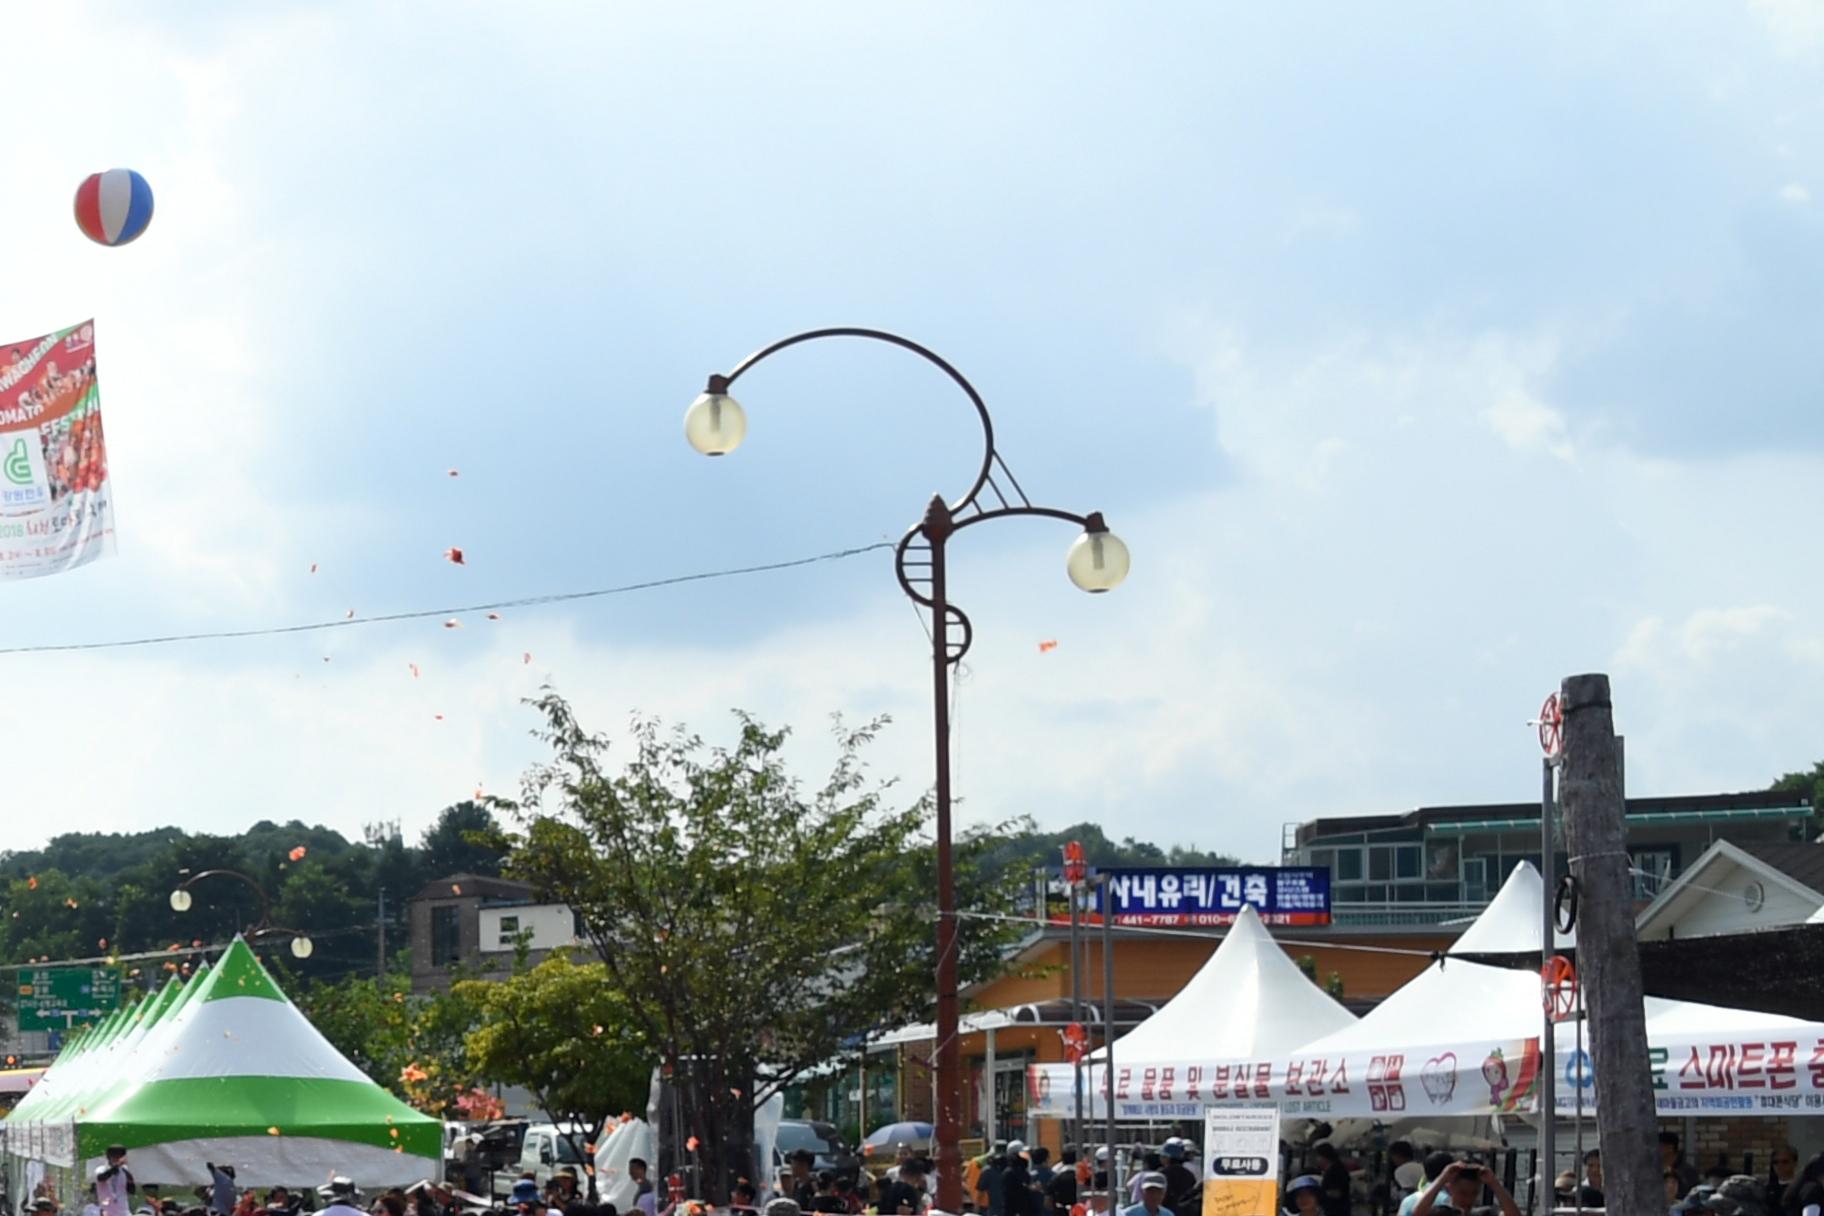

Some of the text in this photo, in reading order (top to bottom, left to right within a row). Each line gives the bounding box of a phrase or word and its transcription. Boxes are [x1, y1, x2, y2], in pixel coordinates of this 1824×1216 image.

[1109, 873, 1269, 909] 사내유리/건축
[1141, 1067, 1174, 1100] 물품
[1186, 1066, 1202, 1100] 및
[1213, 1062, 1272, 1099] 분실물
[1284, 1057, 1350, 1096] 보관소
[1678, 1041, 1798, 1090] 스마트폰
